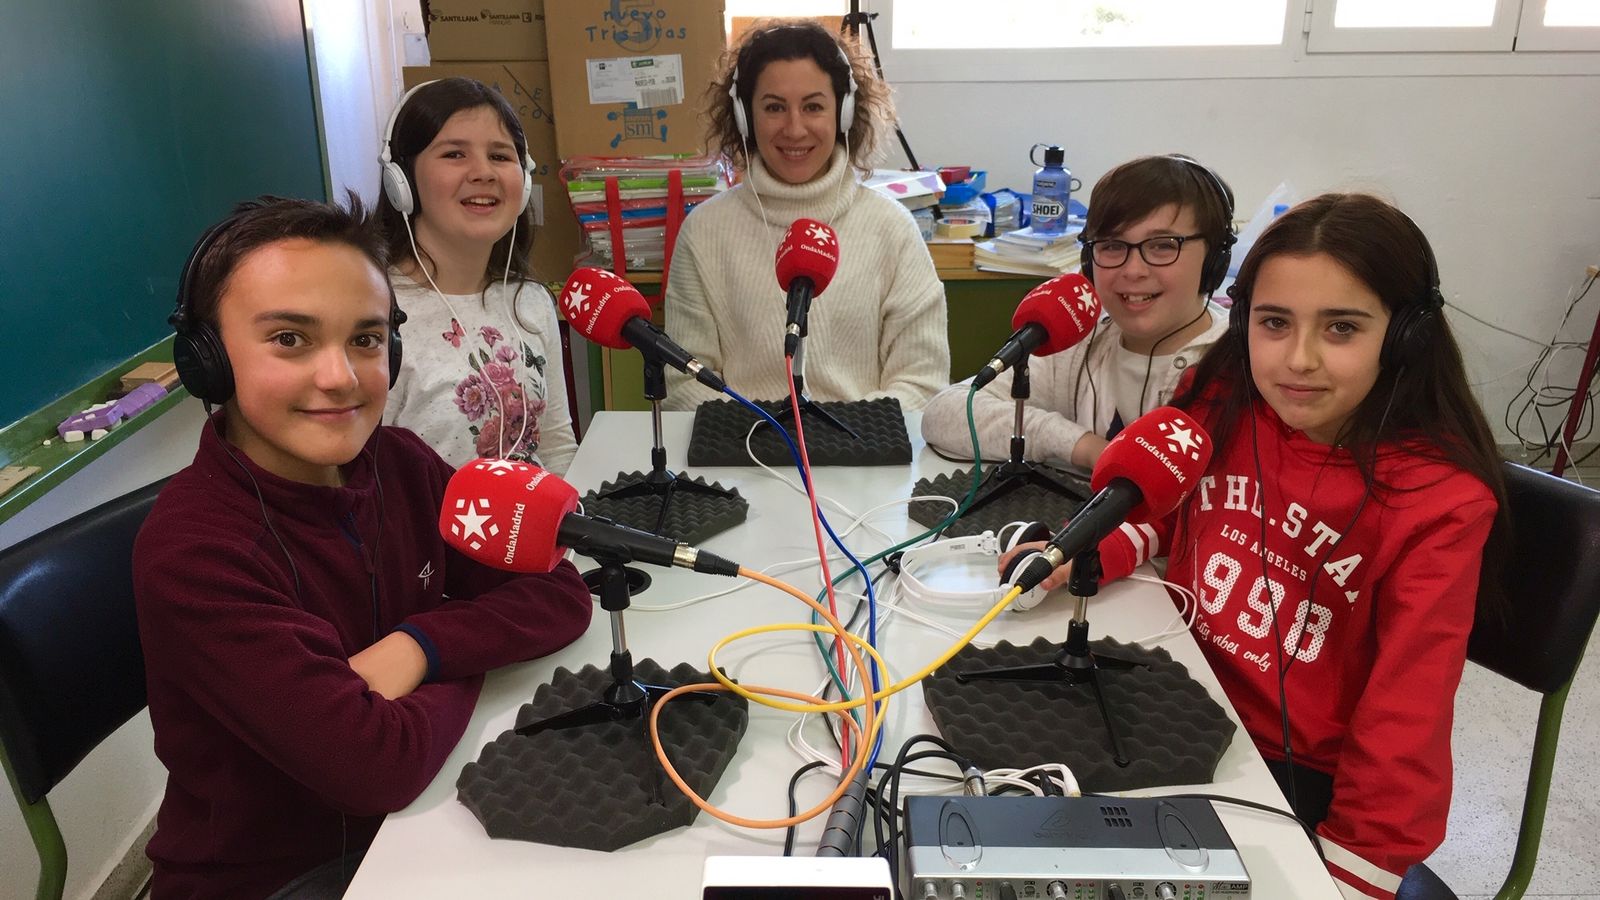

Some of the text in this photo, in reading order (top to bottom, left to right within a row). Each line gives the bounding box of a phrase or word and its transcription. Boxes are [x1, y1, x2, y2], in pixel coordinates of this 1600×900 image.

[604, 9, 667, 21] nuevo
[626, 122, 651, 137] sm
[1032, 203, 1060, 216] SHOEI
[800, 243, 836, 263] OndaMadrid
[585, 292, 612, 335] OndaMadrid
[1057, 295, 1085, 333] OndaMadrid
[1134, 436, 1187, 484] OndaMadrid
[504, 502, 526, 565] OndaMadrid
[1220, 524, 1308, 582] LOS ANGELES
[1199, 551, 1334, 664] 998
[1212, 633, 1241, 655] vibes
[1242, 650, 1273, 673] only
